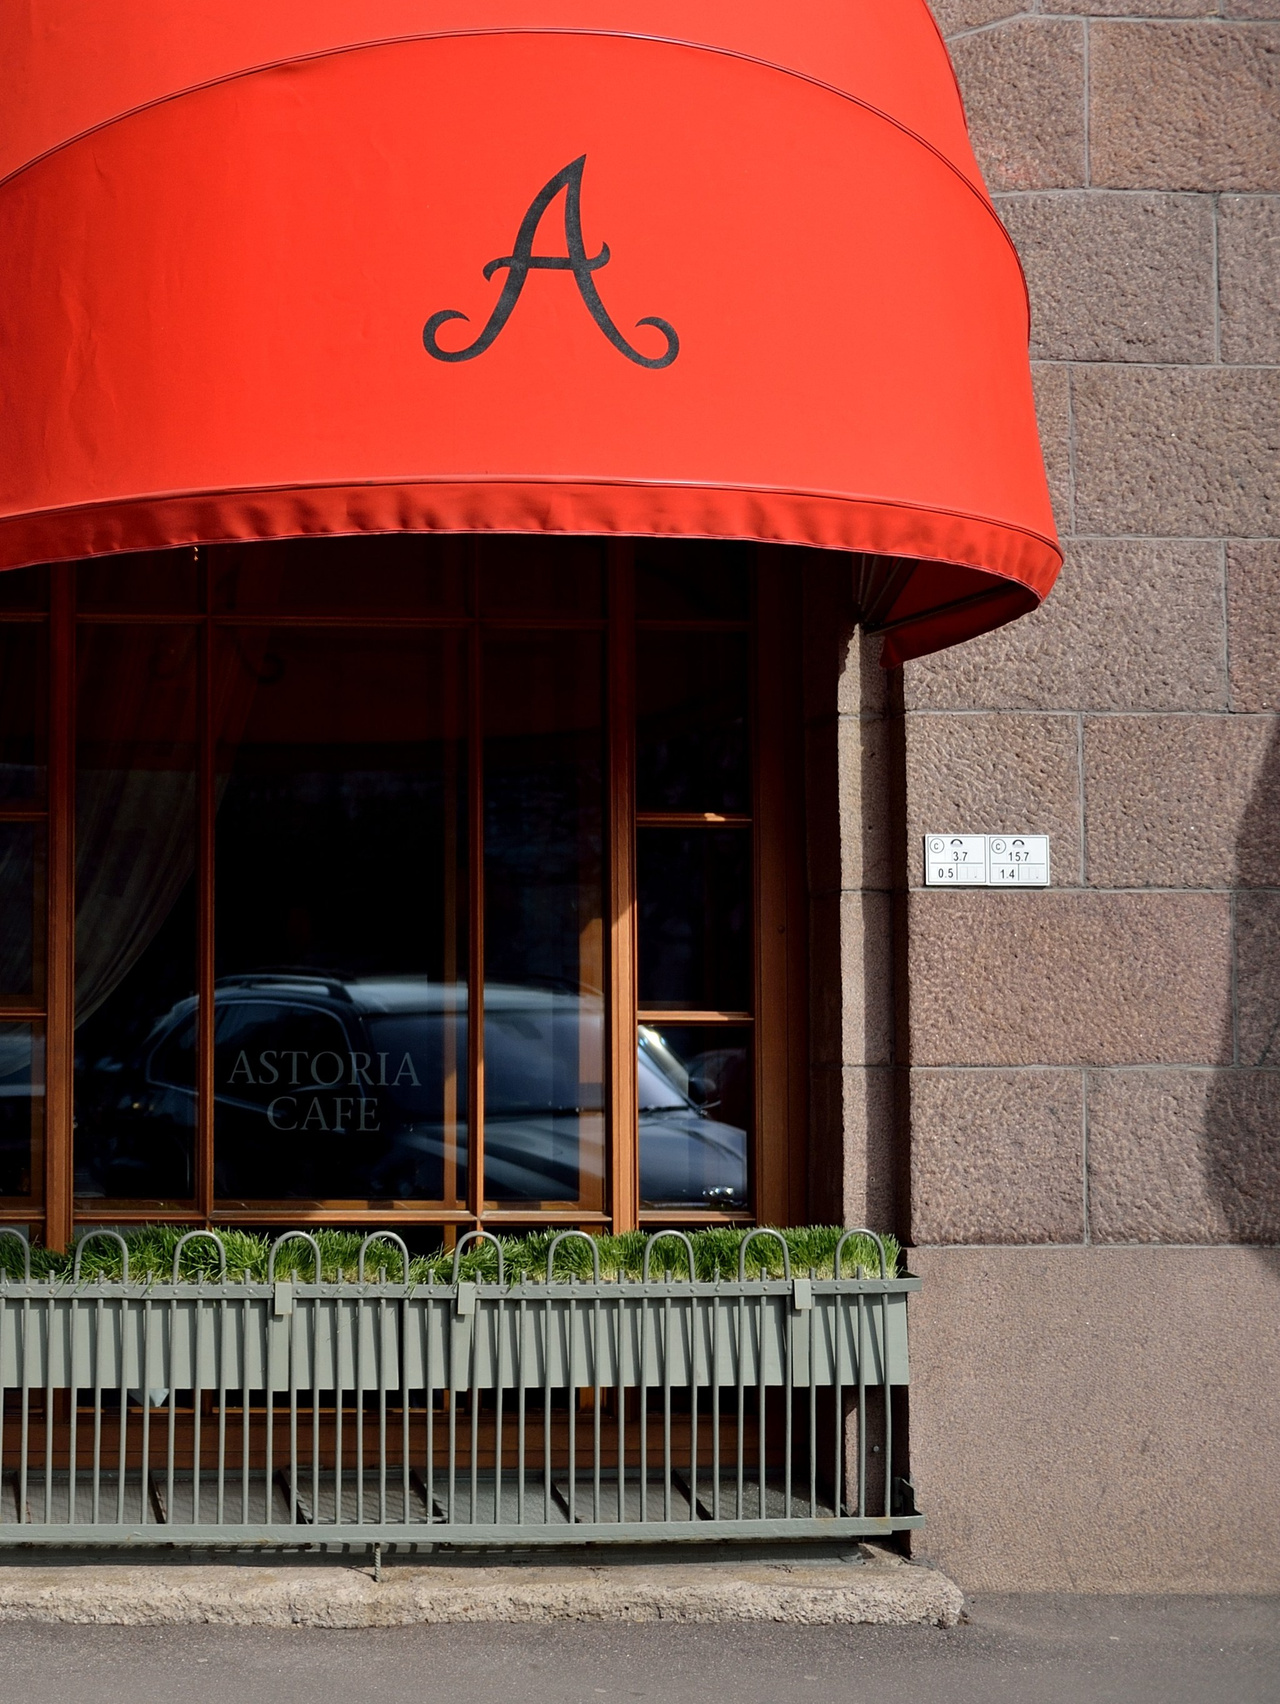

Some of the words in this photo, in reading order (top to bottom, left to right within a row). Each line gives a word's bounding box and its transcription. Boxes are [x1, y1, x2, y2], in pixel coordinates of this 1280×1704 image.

[423, 153, 680, 370] A
[226, 1049, 422, 1087] ASTORIA
[266, 1096, 381, 1132] CAFE
